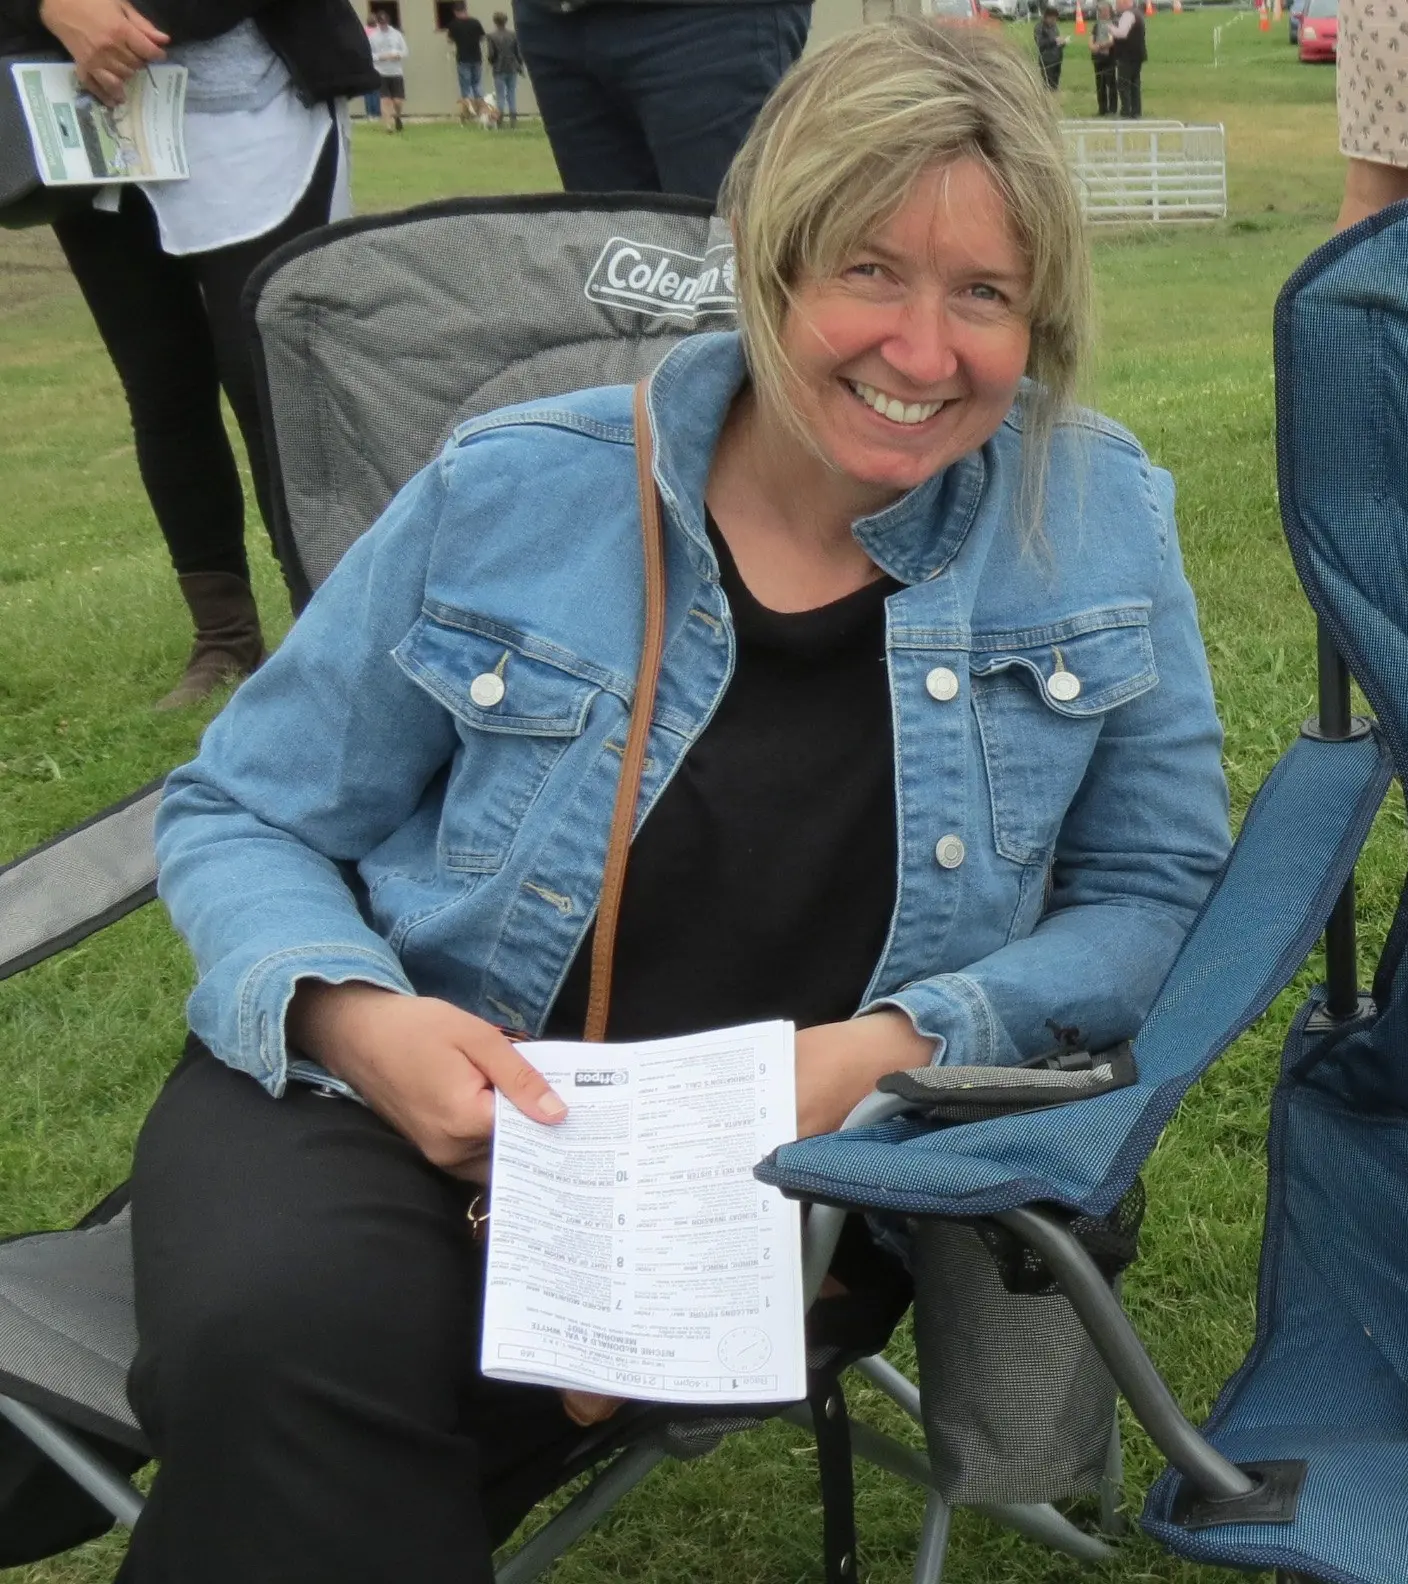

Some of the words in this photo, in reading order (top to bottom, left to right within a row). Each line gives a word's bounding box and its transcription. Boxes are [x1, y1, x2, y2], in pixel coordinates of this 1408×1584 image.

[608, 247, 719, 301] Colemn
[759, 1064, 766, 1075] 6
[576, 1072, 626, 1086] eftpos
[760, 1107, 767, 1118] 5
[616, 1171, 629, 1182] 10
[762, 1200, 769, 1212] 3
[618, 1214, 625, 1225] 9
[692, 1216, 726, 1225] INVASION
[763, 1248, 770, 1260] 2
[617, 1256, 624, 1268] 8
[582, 1301, 611, 1313] SACRED
[616, 1300, 622, 1310] 7
[765, 1296, 770, 1308] 1
[531, 1322, 560, 1334] WHYTE
[567, 1324, 587, 1335] TROT
[564, 1330, 578, 1342] VAL
[592, 1331, 636, 1345] MEMORIAL
[591, 1338, 637, 1353] McDONALD
[641, 1347, 675, 1357] RITCHIE
[615, 1372, 656, 1386] 2180M
[732, 1379, 739, 1389] 1
[743, 1377, 768, 1385] Race
